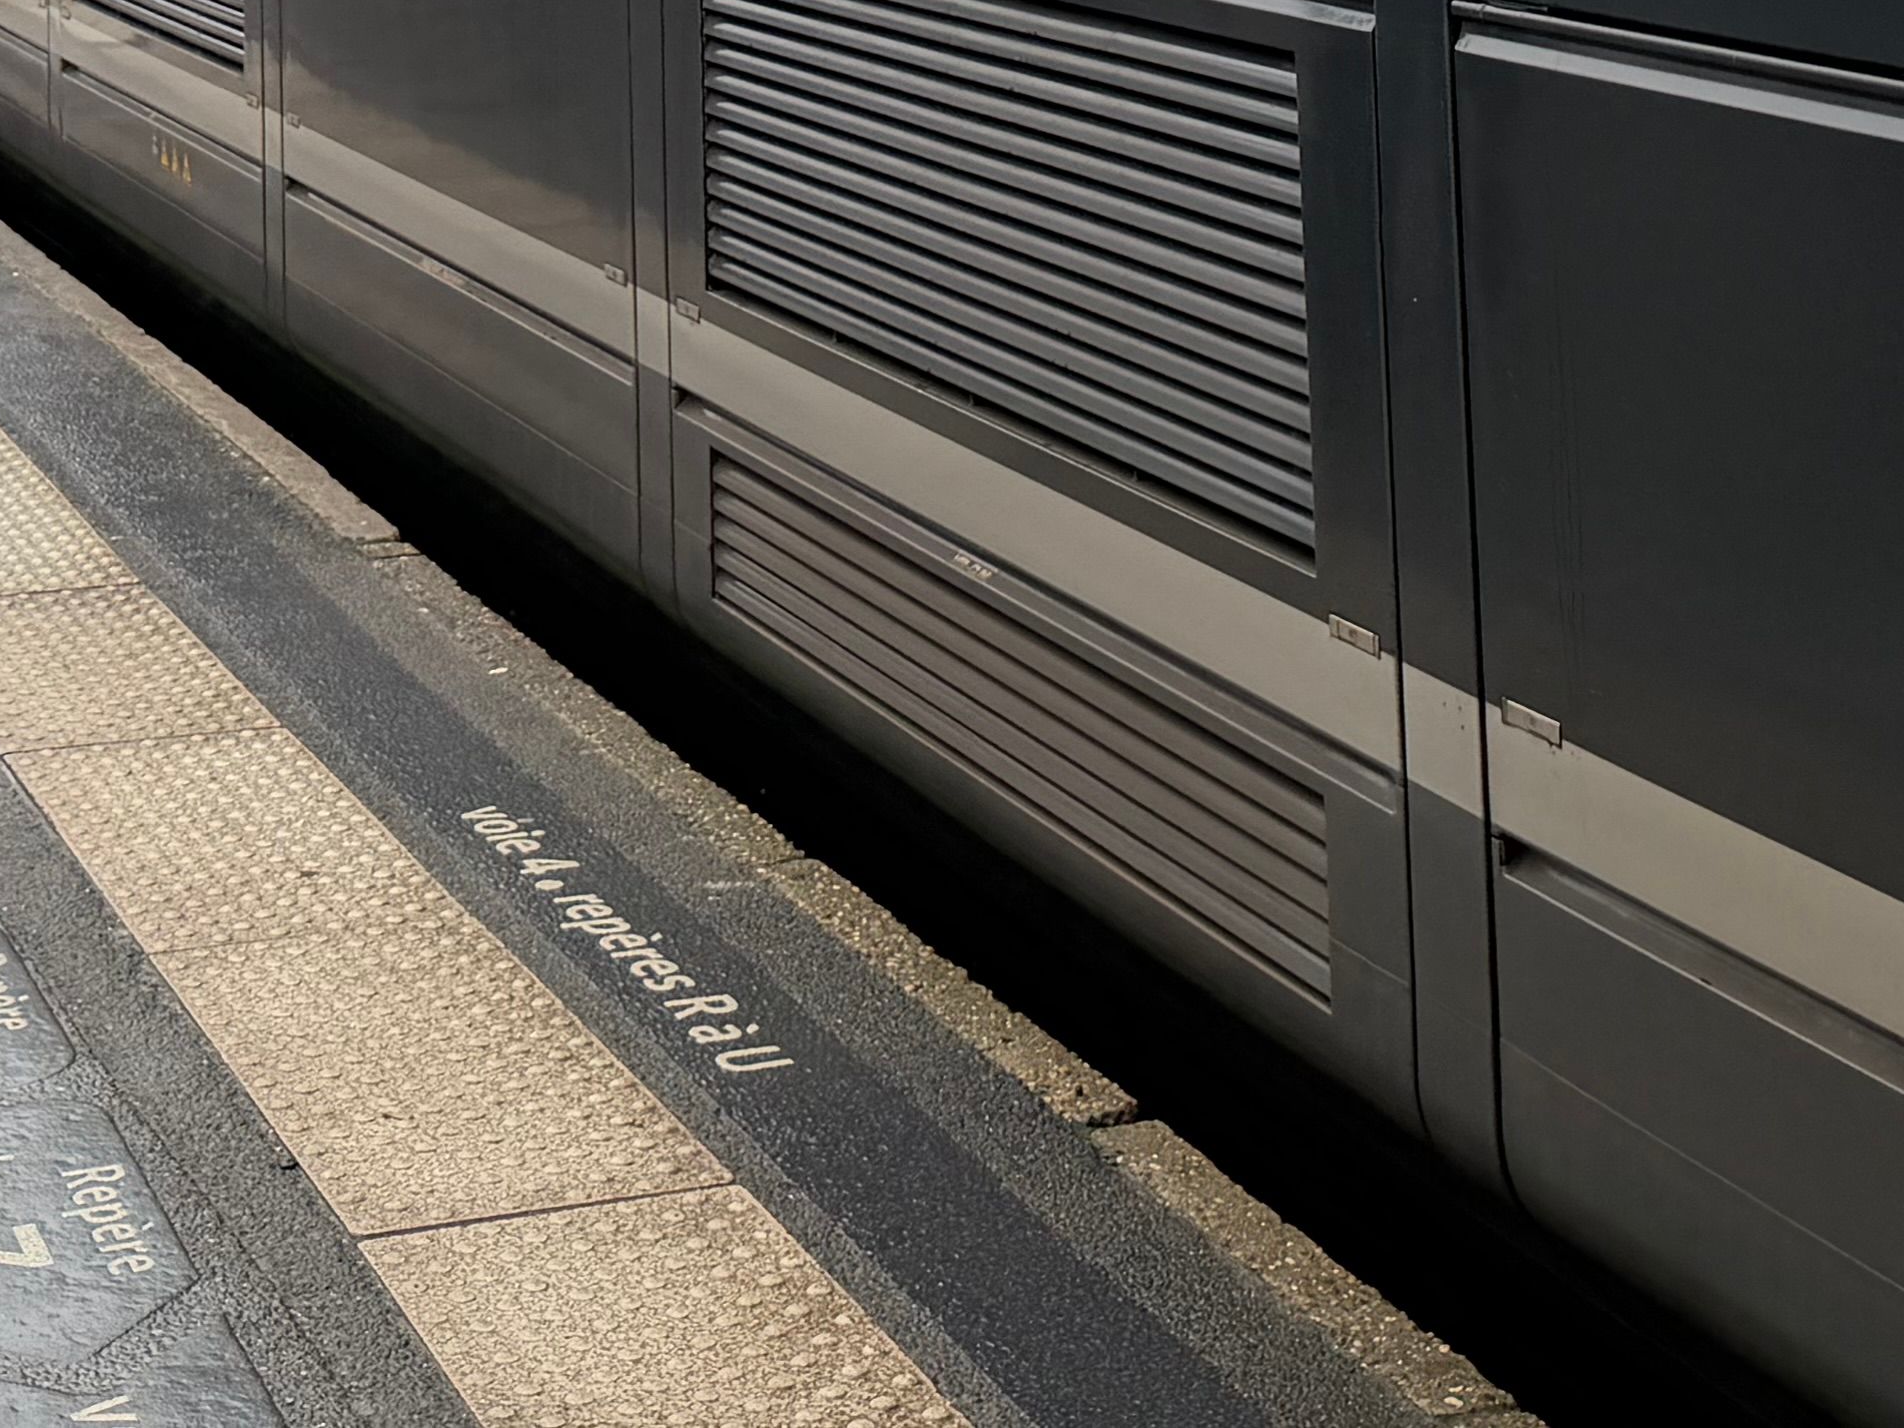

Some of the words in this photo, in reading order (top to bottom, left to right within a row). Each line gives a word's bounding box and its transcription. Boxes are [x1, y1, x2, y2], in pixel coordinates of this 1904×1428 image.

[461, 806, 545, 855] voie
[520, 859, 580, 874] 4
[553, 894, 696, 991] repères
[664, 994, 739, 1020] R
[688, 1023, 759, 1043] à
[715, 1045, 794, 1072] U
[61, 1164, 155, 1276] Repère
